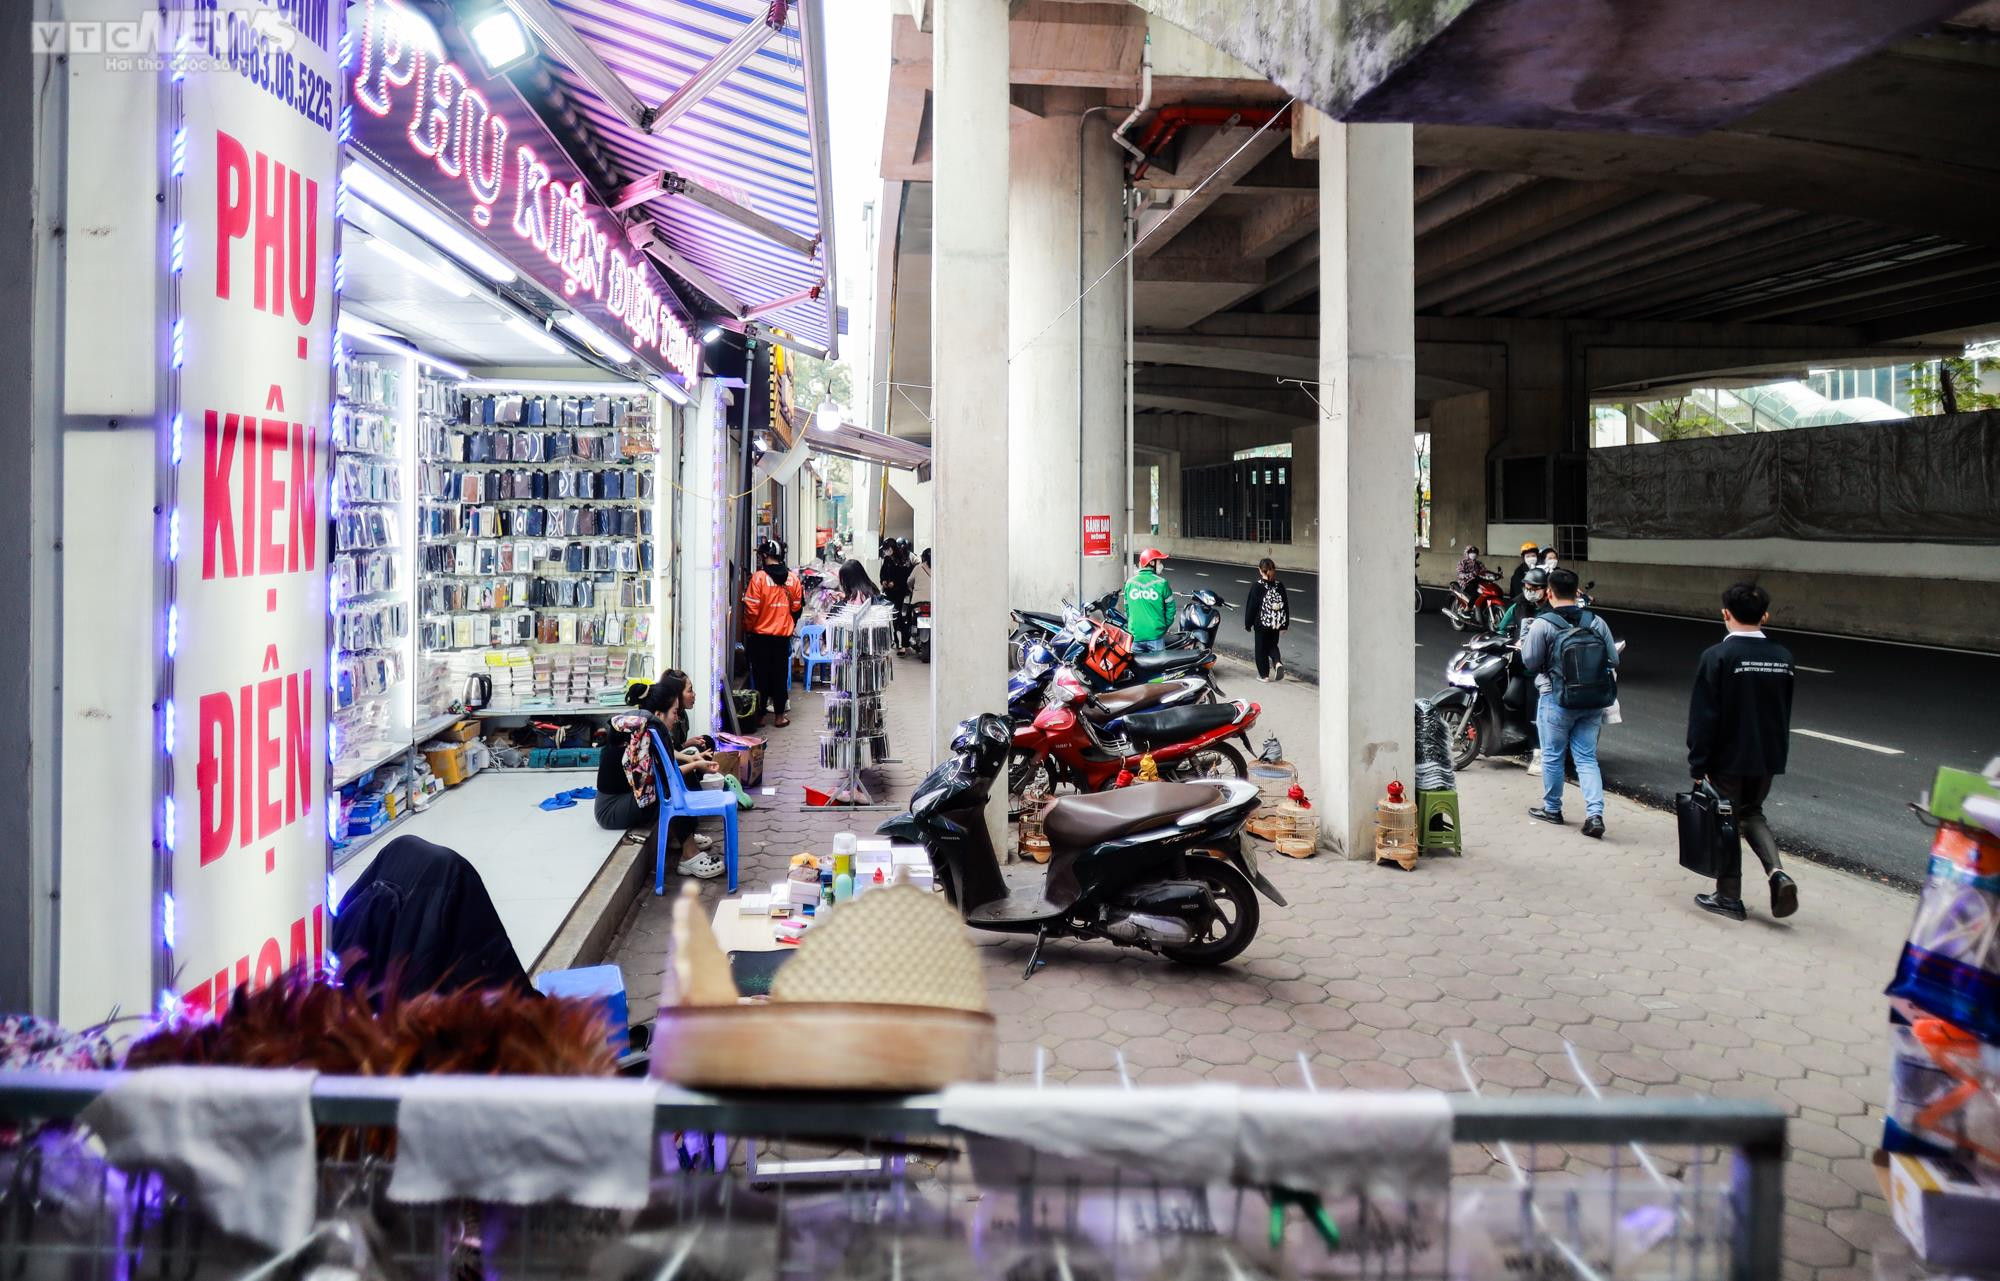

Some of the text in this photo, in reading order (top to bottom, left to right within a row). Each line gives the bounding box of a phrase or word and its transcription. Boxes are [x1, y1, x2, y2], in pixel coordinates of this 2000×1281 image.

[228, 11, 333, 132] 0963.06.5225
[216, 129, 318, 360] PHỤ
[513, 145, 609, 300] KIỆN
[606, 248, 661, 349] ĐIỆN
[202, 384, 316, 612] KIỆN
[1130, 588, 1158, 601] Grab
[197, 644, 312, 874] ĐIỆN
